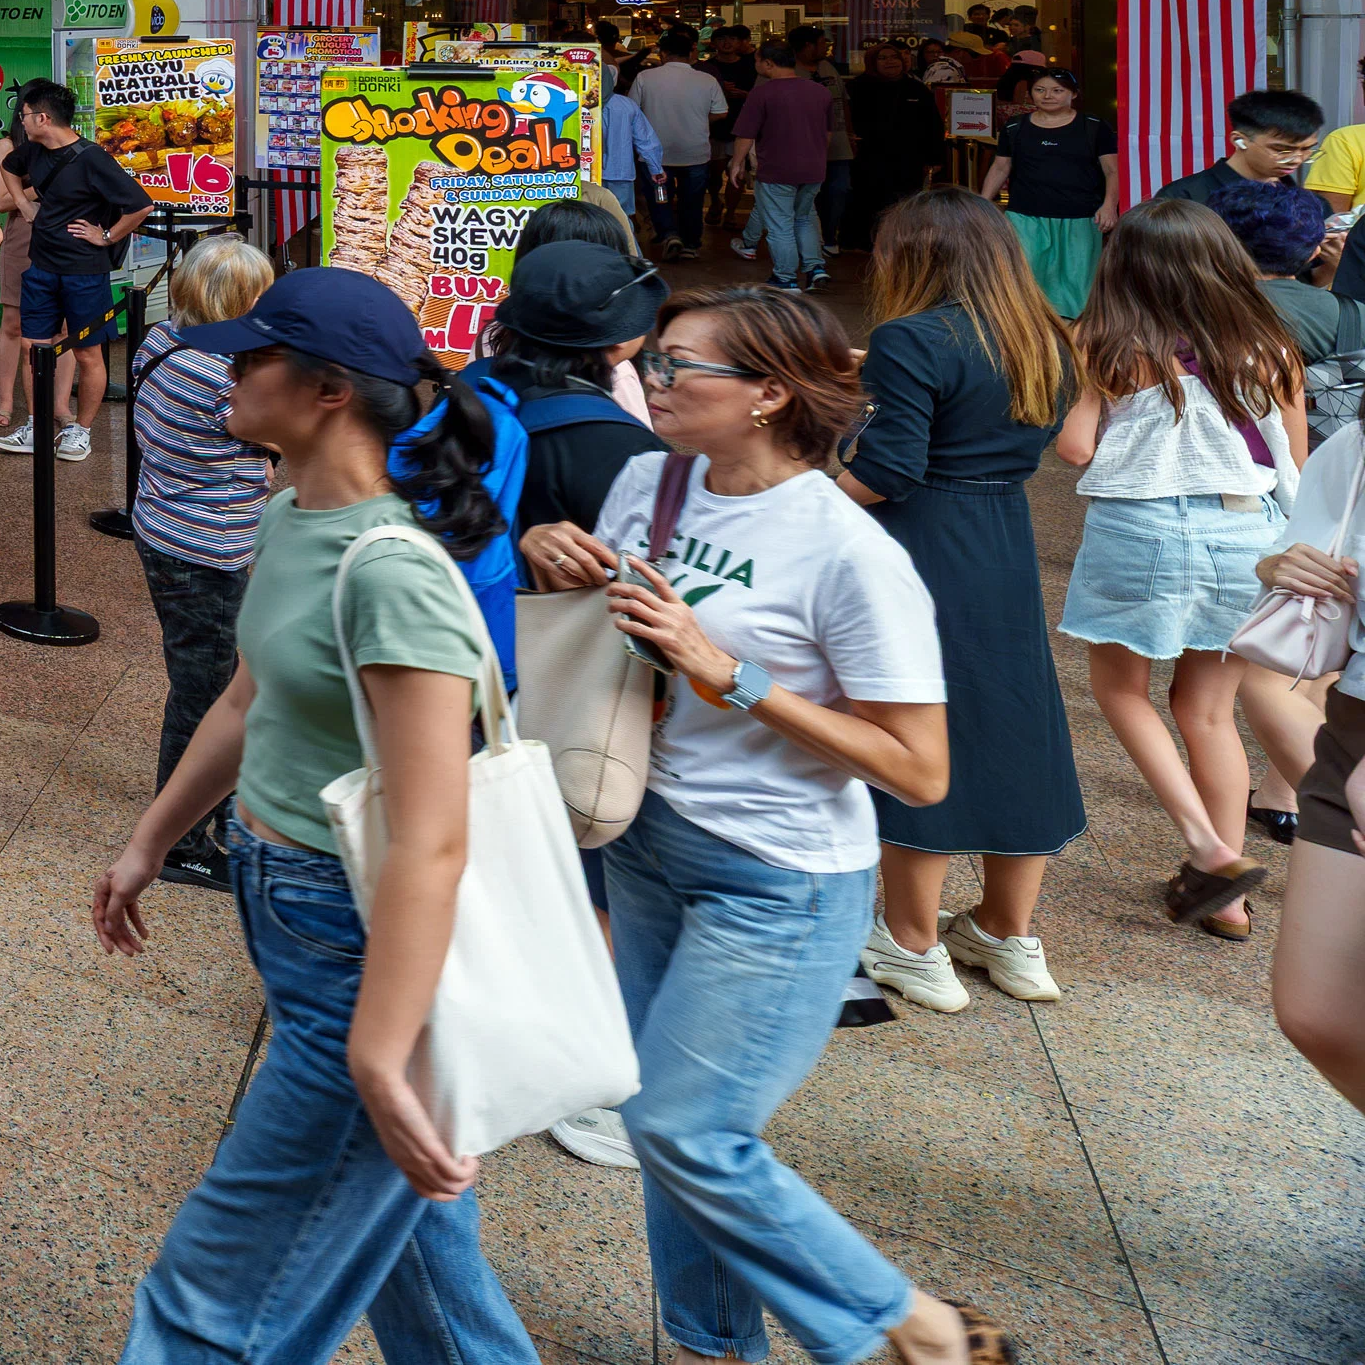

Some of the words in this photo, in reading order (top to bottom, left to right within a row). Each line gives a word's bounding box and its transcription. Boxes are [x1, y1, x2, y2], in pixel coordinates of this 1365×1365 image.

[22, 7, 44, 20] EN
[85, 5, 107, 18] ITO
[108, 4, 125, 18] EN
[312, 34, 356, 43] GROCERY
[97, 52, 154, 66] FRESHLY
[156, 44, 233, 62] LAUNCHED!
[305, 48, 361, 56] PROMOTION
[110, 59, 184, 78] WAGYU
[532, 60, 559, 69] 2025
[98, 72, 201, 93] MEATBALL
[358, 82, 402, 93] DONKI
[101, 86, 202, 106] BAGUETTE
[322, 89, 512, 142] Shocking
[434, 121, 578, 175] Deals
[141, 153, 234, 194] RM16
[430, 175, 491, 190] FRIDAY,
[492, 172, 576, 187] SATURDAY
[191, 195, 211, 204] PER
[213, 195, 229, 204] PC
[445, 189, 458, 203] &
[459, 188, 523, 203] SUNDAY
[525, 186, 578, 200] ONLY!!
[432, 227, 522, 247] SKEW
[432, 247, 486, 271] 40g
[429, 277, 504, 299] BUY
